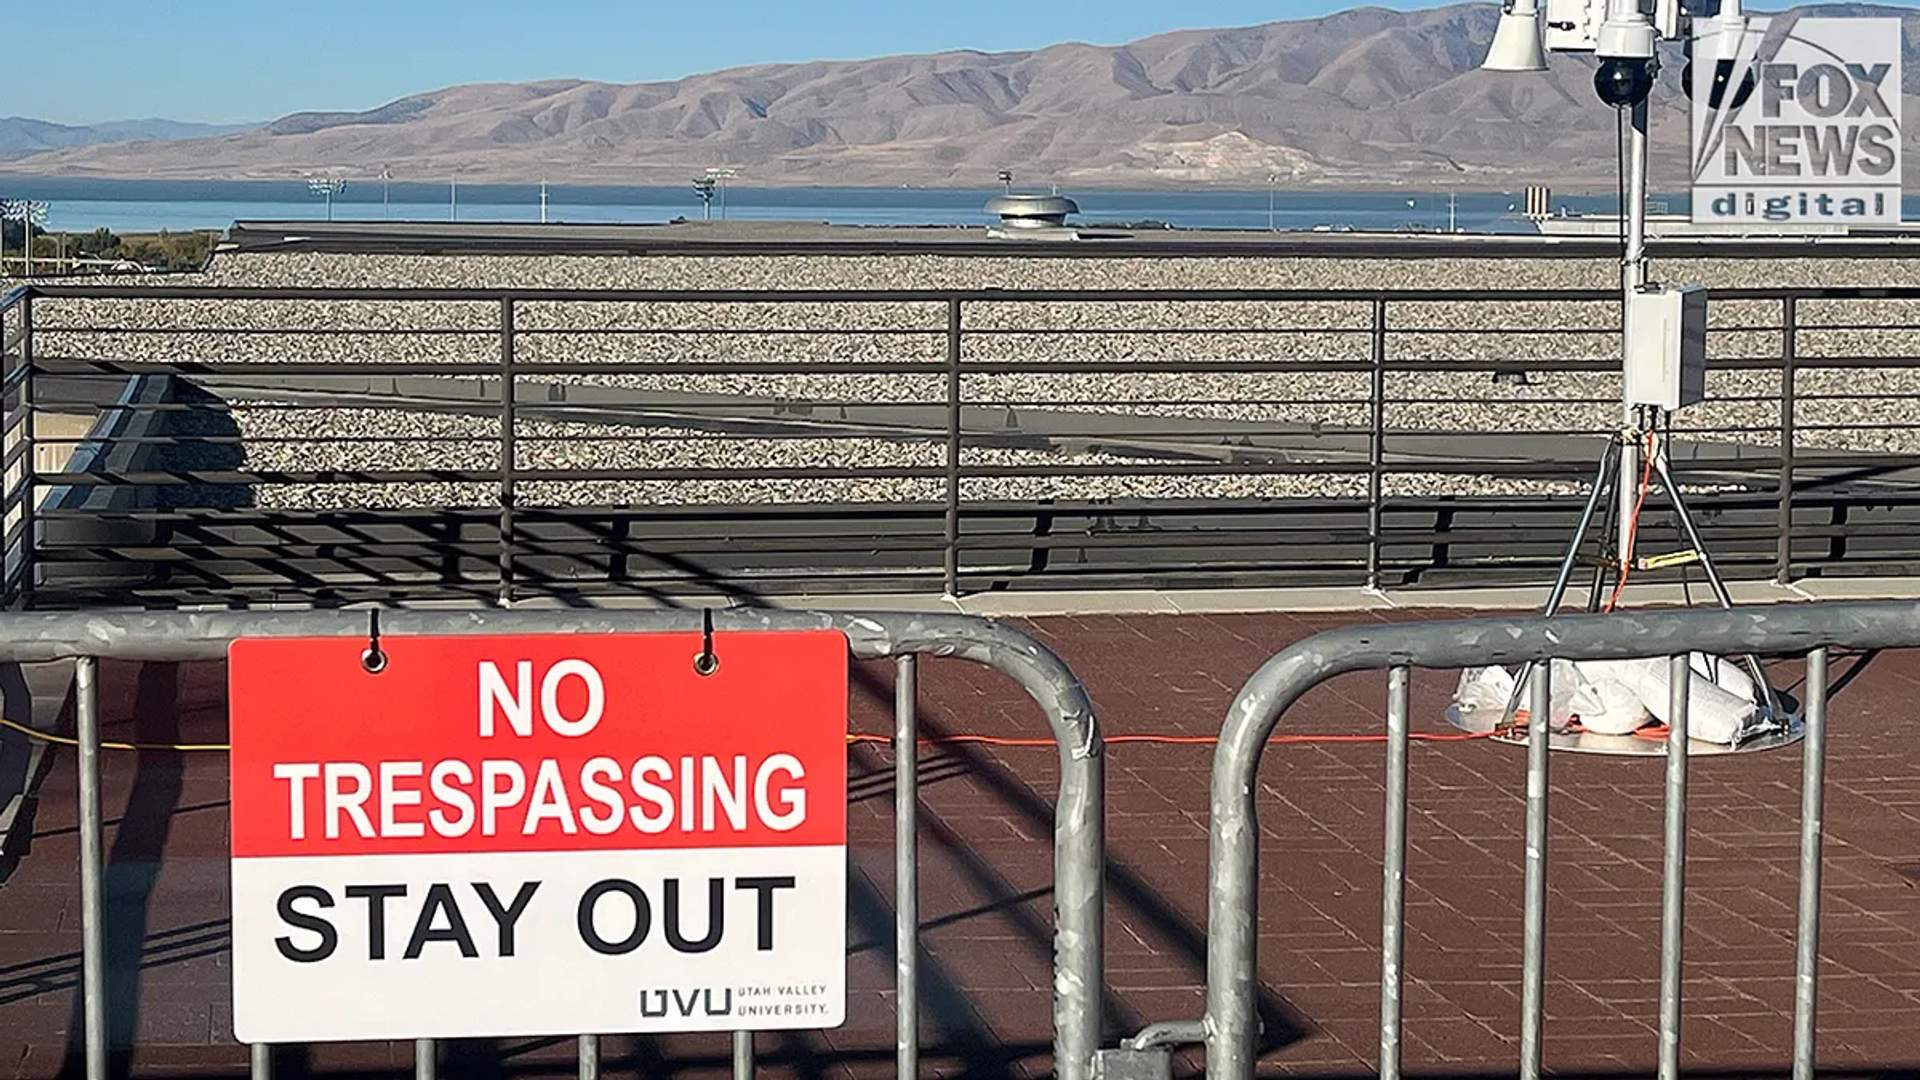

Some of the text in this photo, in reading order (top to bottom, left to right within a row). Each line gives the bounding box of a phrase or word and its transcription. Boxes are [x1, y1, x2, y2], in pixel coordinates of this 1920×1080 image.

[478, 659, 605, 738] NO
[274, 753, 807, 840] TRESPASSING
[275, 876, 796, 963] STAY OUT
[640, 988, 732, 1017] UVU
[738, 985, 827, 997] UTAH VALLEY
